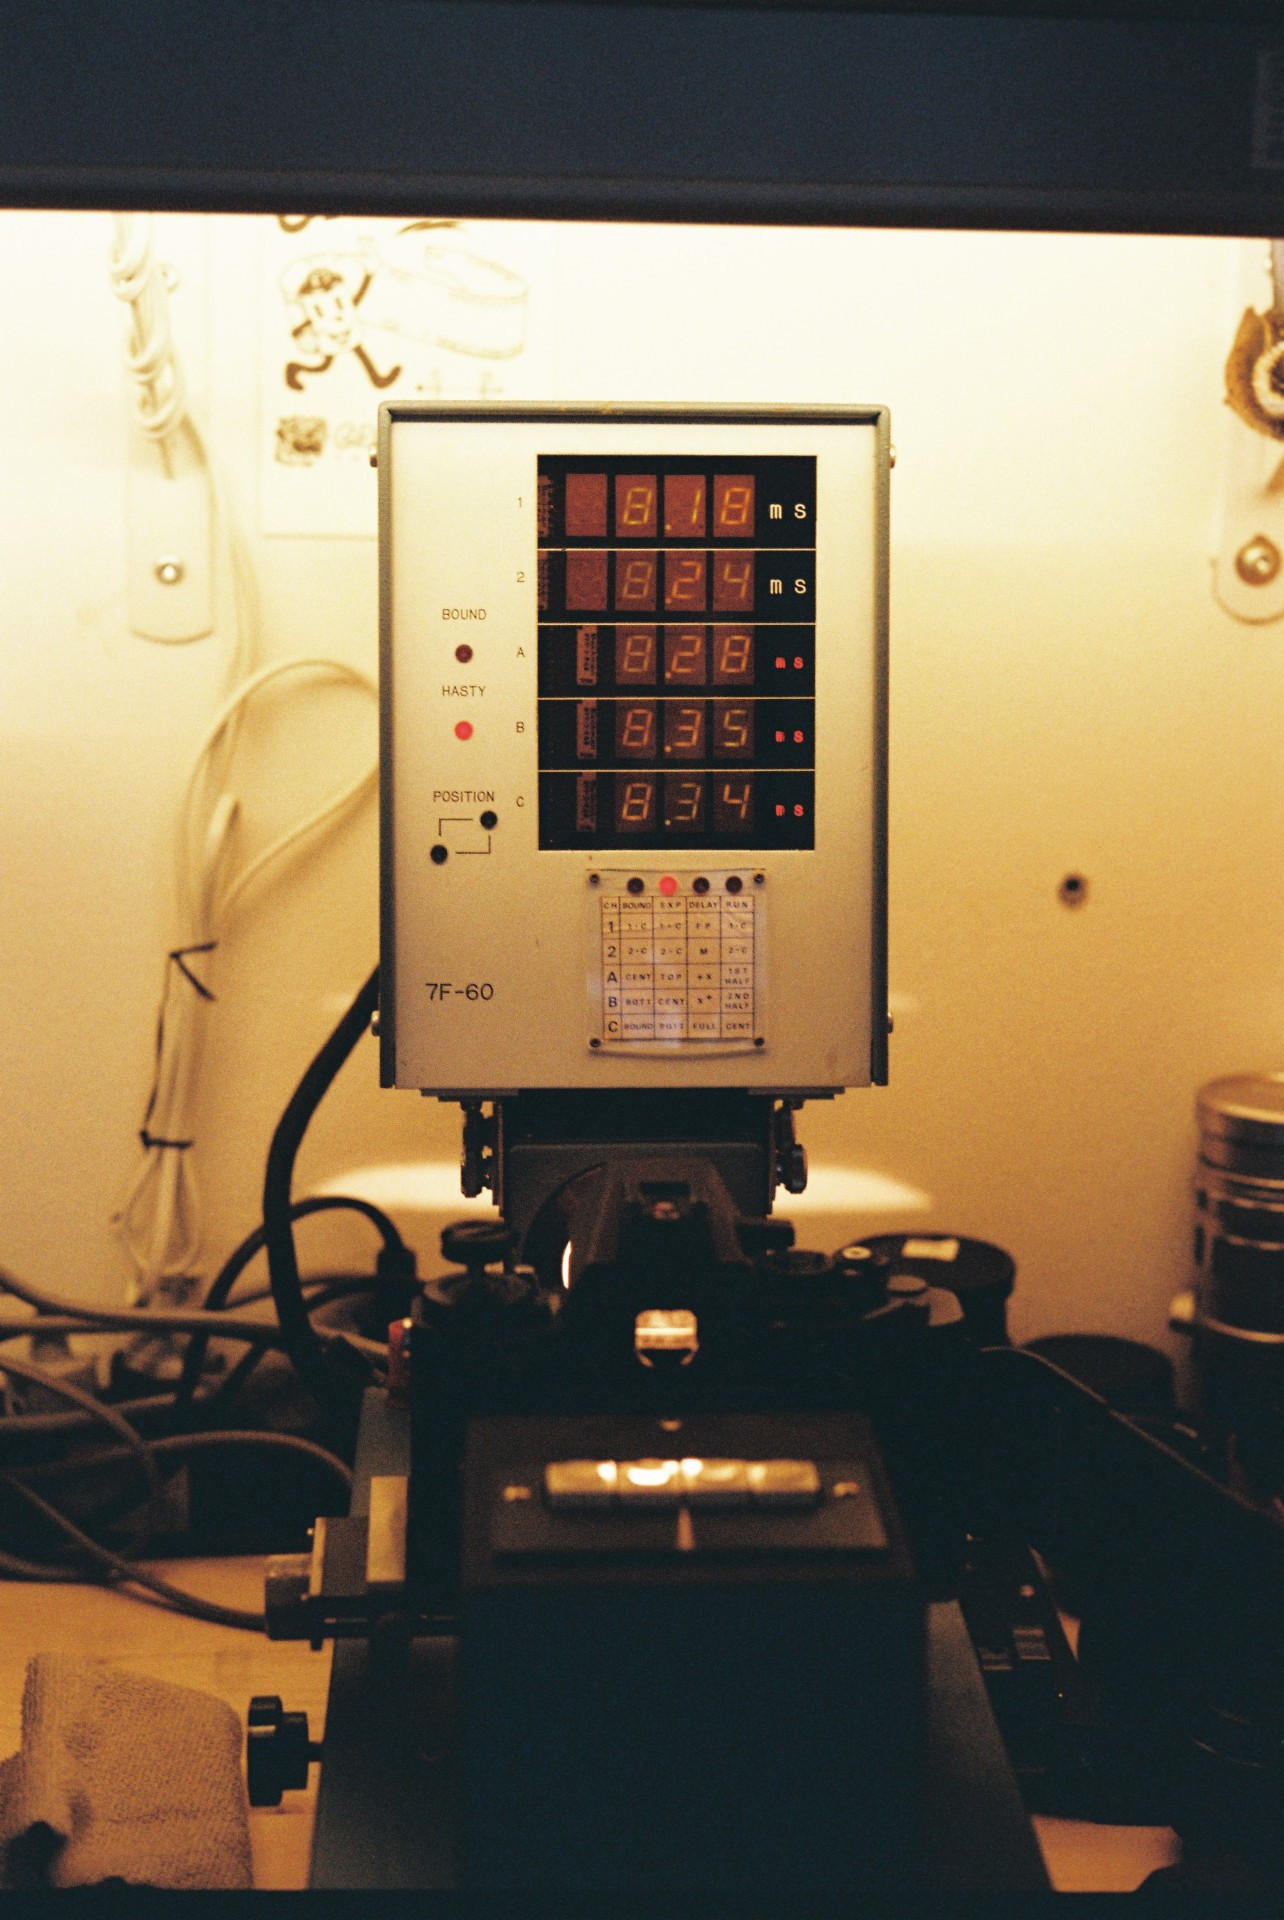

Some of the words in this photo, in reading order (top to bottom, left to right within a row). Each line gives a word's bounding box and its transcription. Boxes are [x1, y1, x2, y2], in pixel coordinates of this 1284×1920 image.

[517, 497, 523, 509] 1
[516, 571, 526, 584] 2
[442, 609, 487, 621] BOUND
[516, 646, 526, 659] A
[442, 685, 486, 698] HASTY
[516, 721, 525, 734] B
[433, 791, 495, 803] POSITION
[516, 796, 525, 808] C
[689, 901, 718, 910] DELAY
[608, 921, 615, 934] 1
[607, 945, 617, 958] 2
[606, 971, 618, 983] A
[426, 983, 494, 1001] 7F-60
[608, 996, 617, 1008] B
[608, 1021, 618, 1033] C
